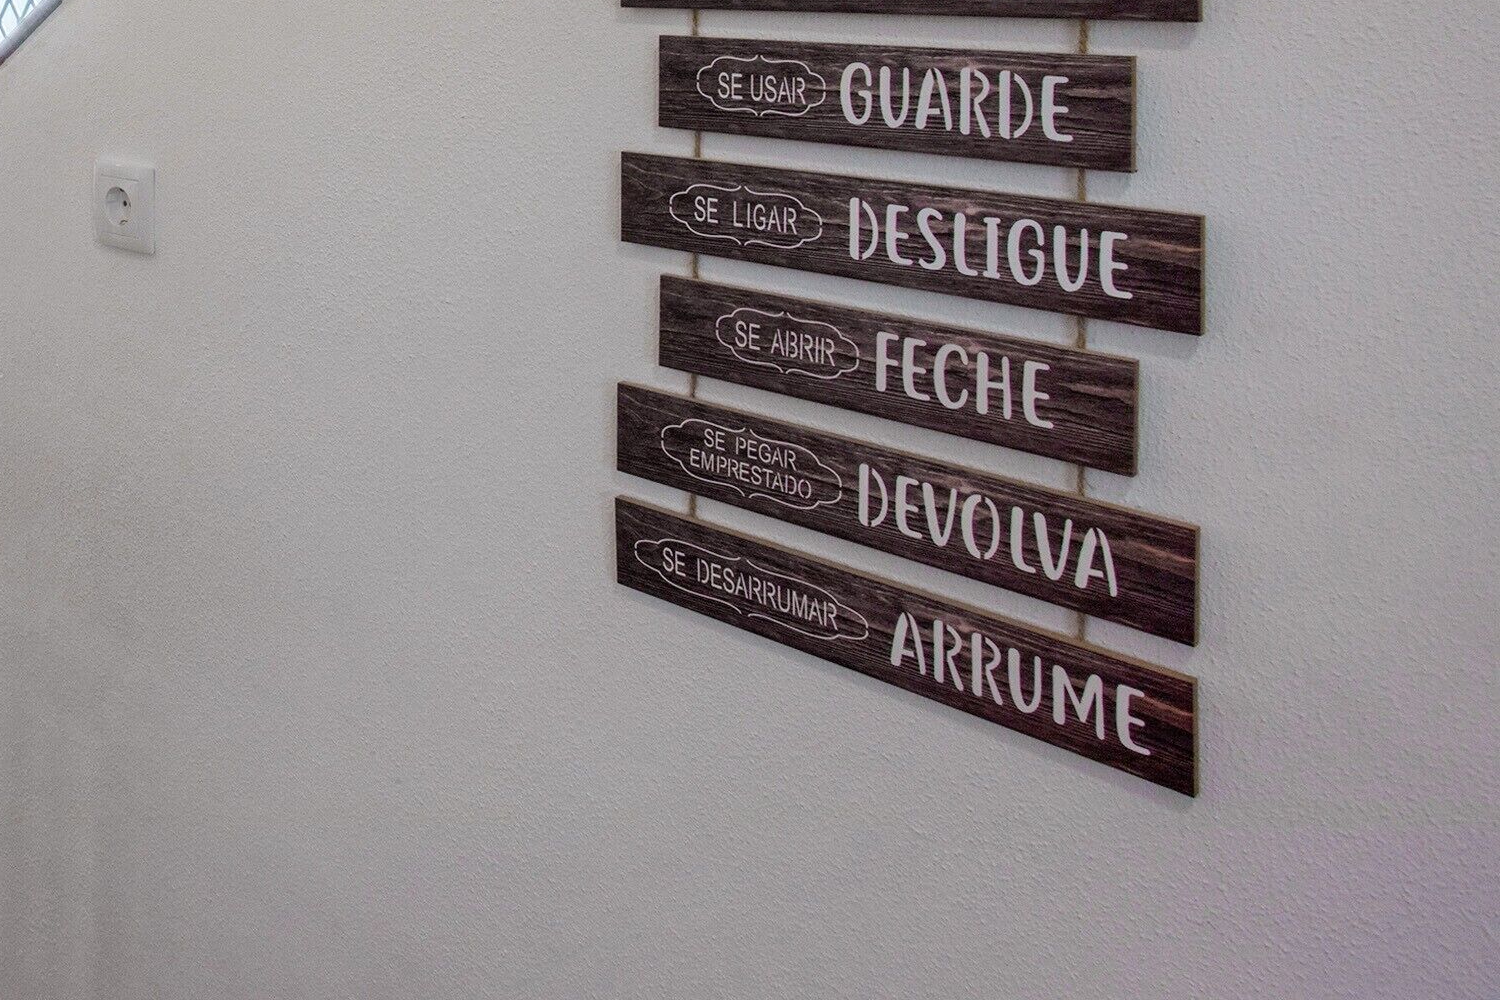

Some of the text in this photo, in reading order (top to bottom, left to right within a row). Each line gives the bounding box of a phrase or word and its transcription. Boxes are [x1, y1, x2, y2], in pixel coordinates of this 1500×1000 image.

[717, 61, 1075, 143] SE USAR GUARDE
[693, 195, 1134, 299] SE LIGAR DESLIGUE
[734, 320, 1054, 430] SE ABRIR FECHE
[689, 449, 812, 500] EMPRESTADO
[703, 428, 798, 472] SE PEGAR
[857, 462, 1118, 598] DEVOLVA
[662, 548, 1152, 756] SE DESARRUMAR ARRUME
